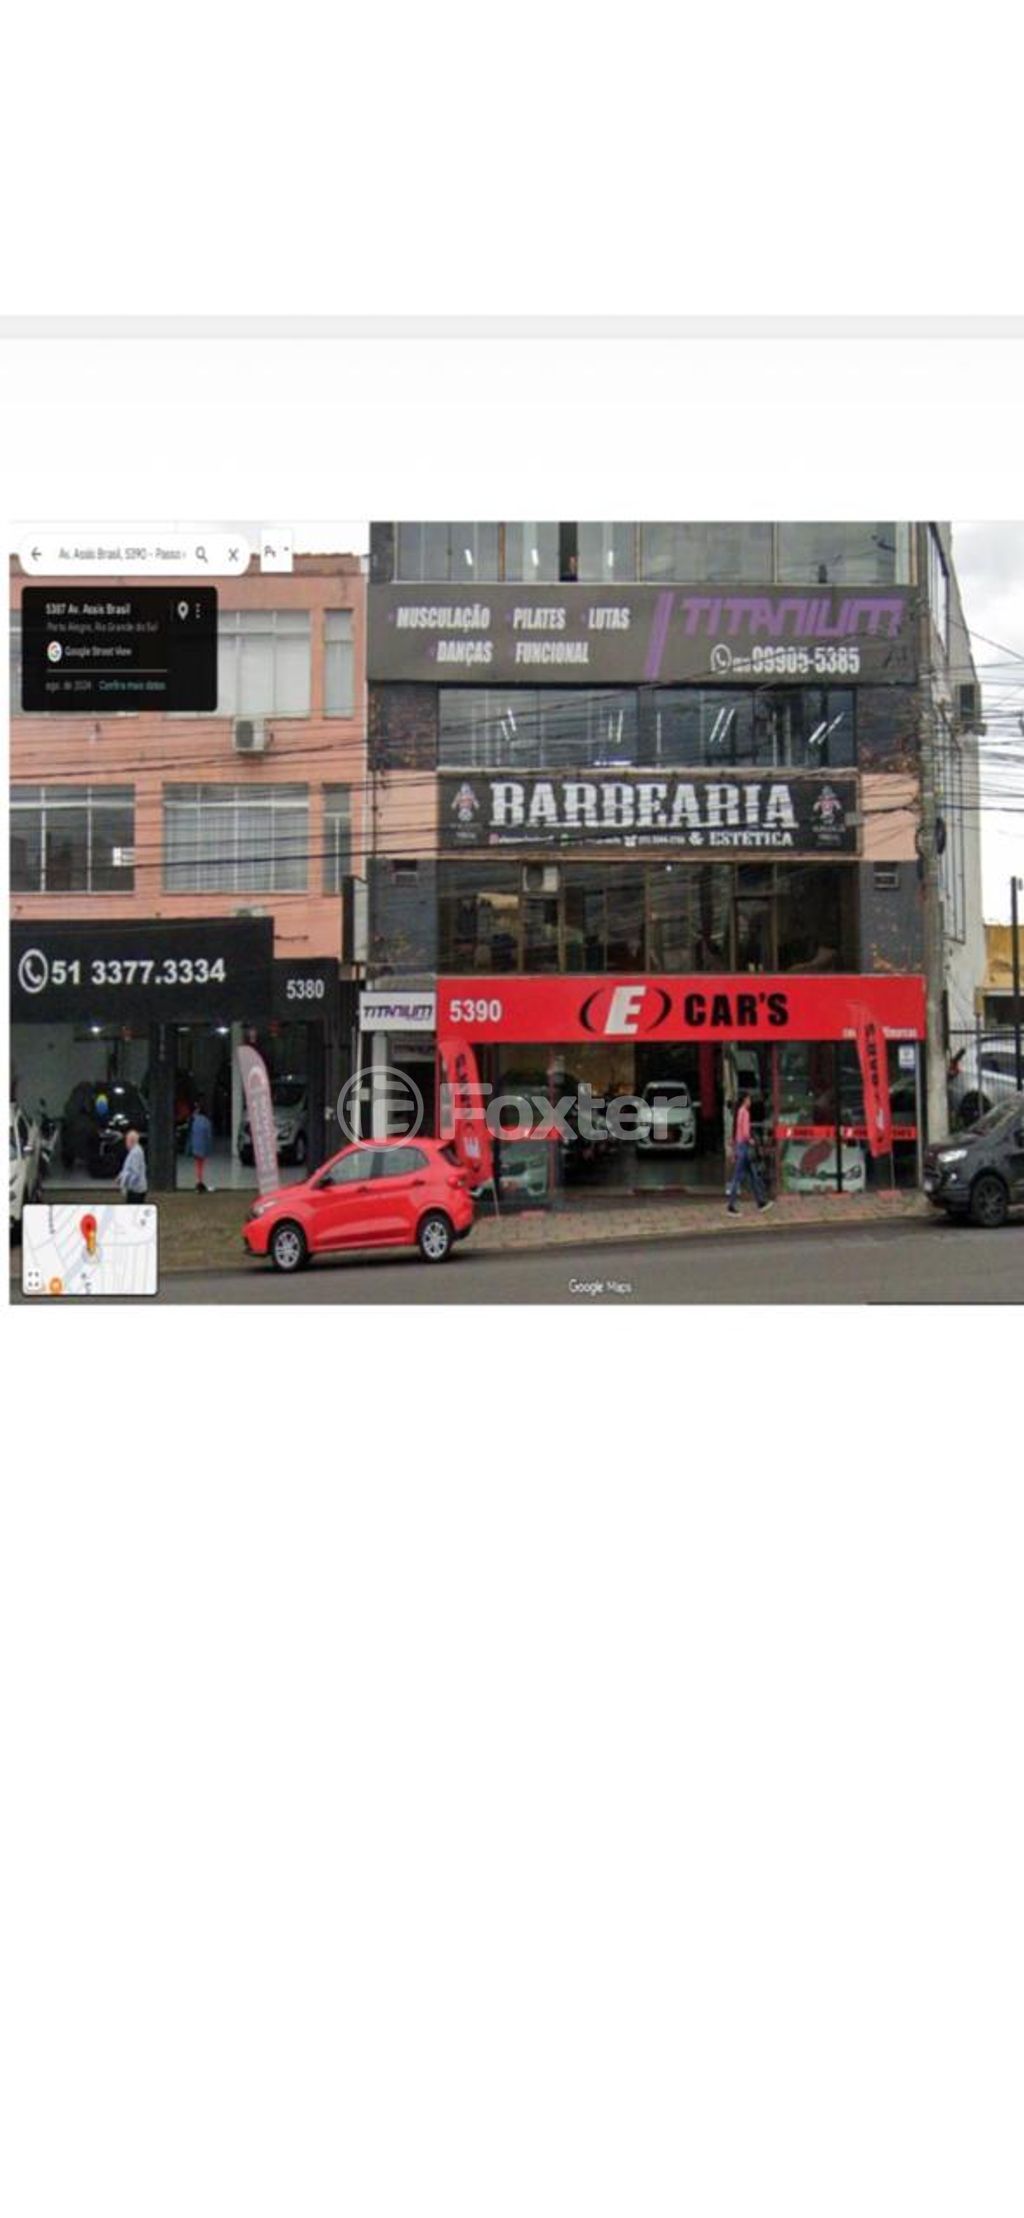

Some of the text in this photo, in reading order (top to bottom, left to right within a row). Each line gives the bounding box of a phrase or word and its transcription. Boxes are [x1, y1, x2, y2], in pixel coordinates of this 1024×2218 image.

[396, 604, 631, 632] MUSCULAÇÃO PILATES LUTAS
[683, 597, 905, 637] TITANIUM
[436, 642, 590, 666] DANÇAS FUNCIONAL
[489, 781, 799, 829] BARBEARIA
[689, 831, 704, 846] &
[52, 958, 226, 985] 51 3377.3334
[286, 979, 325, 999] 5380
[449, 999, 503, 1023] 5390
[684, 993, 790, 1027] CAR'S
